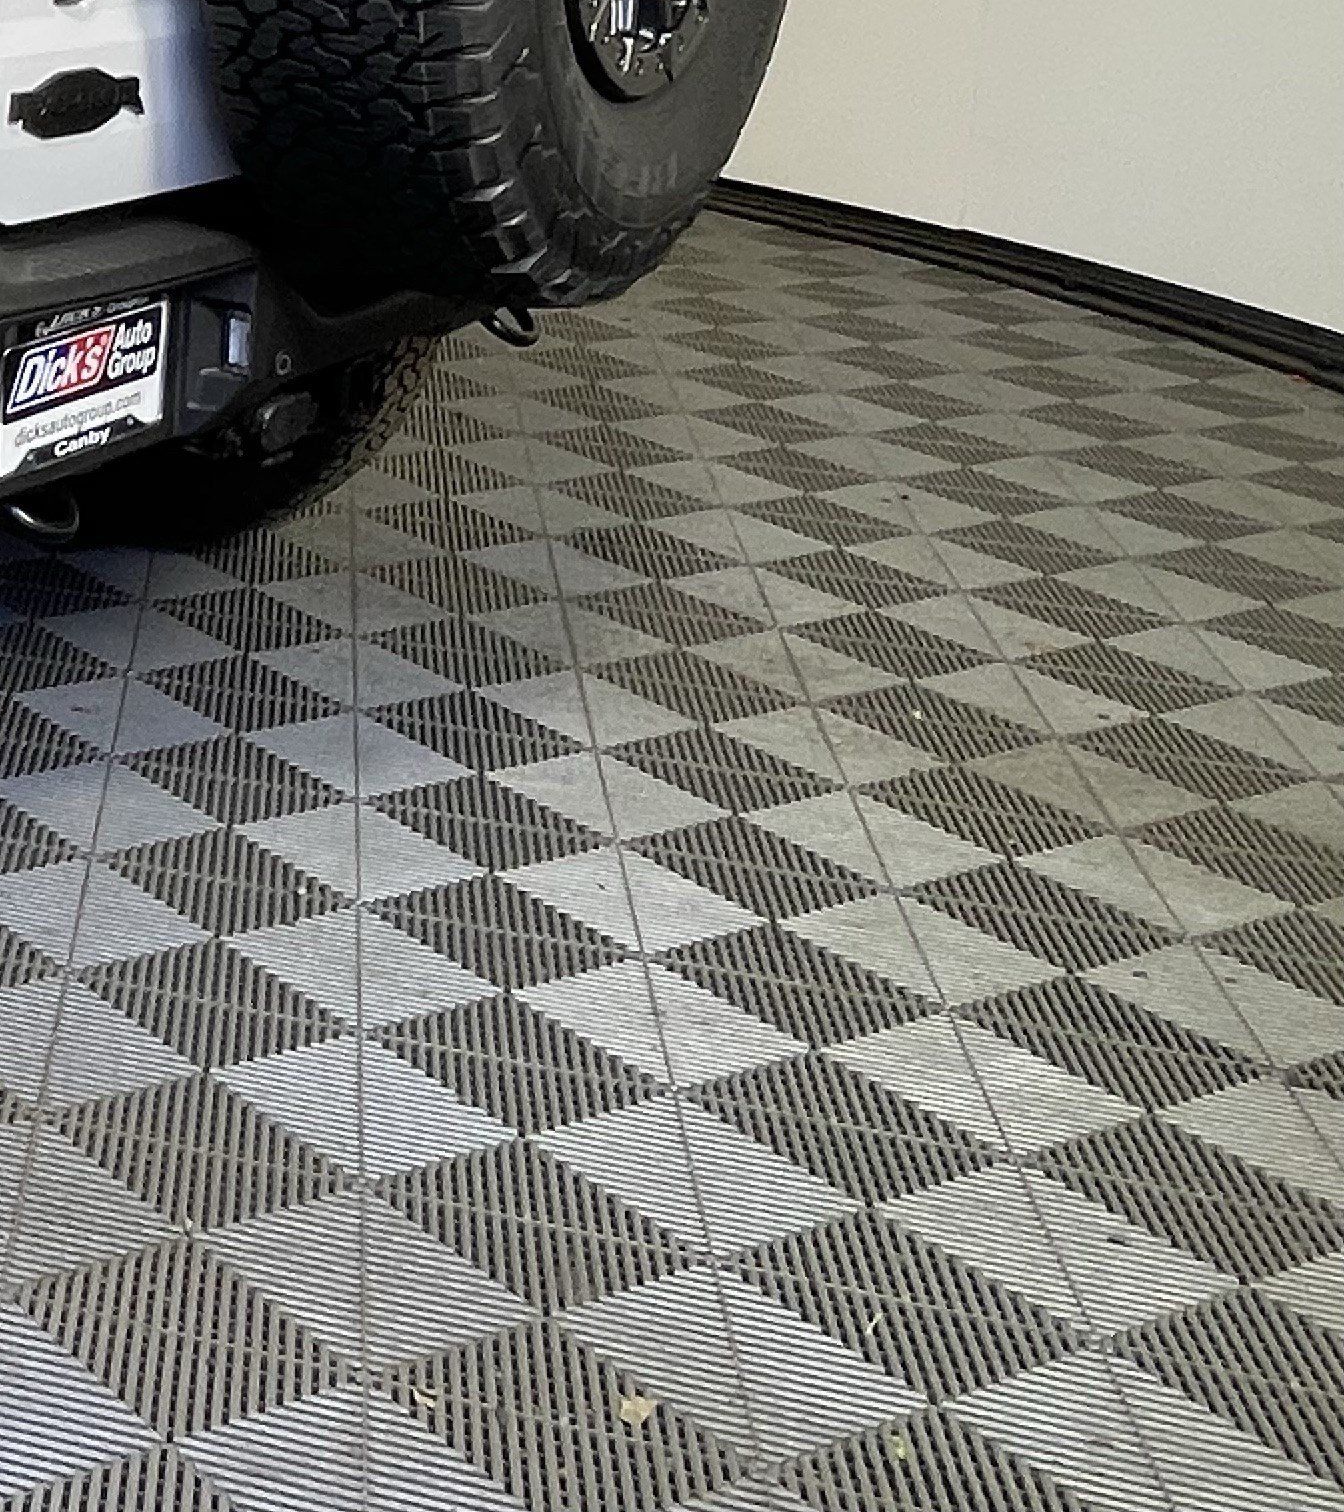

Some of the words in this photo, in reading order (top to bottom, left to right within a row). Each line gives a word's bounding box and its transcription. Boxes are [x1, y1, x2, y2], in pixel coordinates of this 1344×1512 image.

[112, 319, 153, 351] Auto
[14, 336, 105, 404] Dick's
[107, 346, 156, 379] Group
[54, 426, 111, 458] Canby
